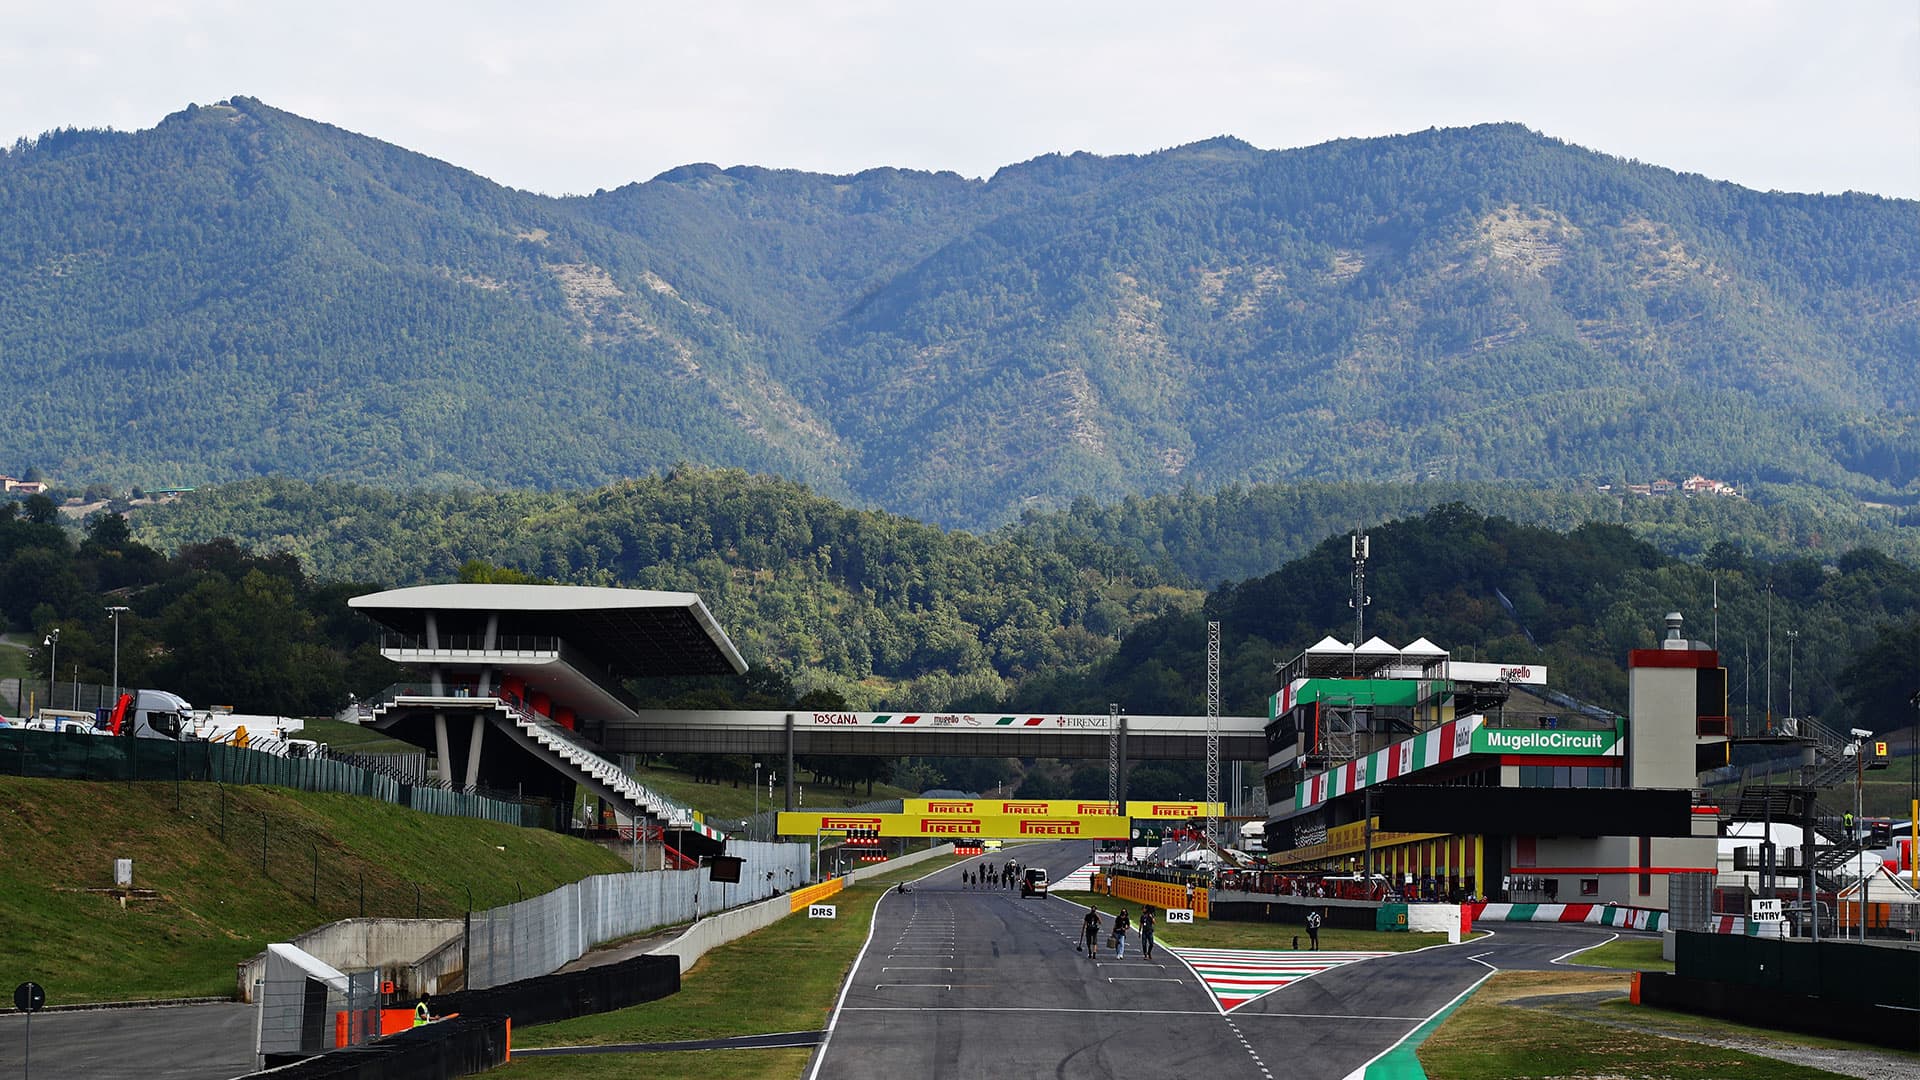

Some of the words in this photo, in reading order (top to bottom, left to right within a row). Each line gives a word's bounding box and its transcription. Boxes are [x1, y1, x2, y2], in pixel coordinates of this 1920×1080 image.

[1067, 716, 1108, 729] FIRENZE
[1487, 732, 1603, 750] MugelloCircuit
[1877, 744, 1885, 754] F
[928, 802, 974, 814] PIRELLI
[1003, 803, 1049, 815] PIRELLI
[1078, 804, 1120, 815] PIRELL
[1153, 805, 1199, 816] PIRELLI
[921, 819, 981, 834] PIRELLI
[1020, 820, 1081, 835] PIRELLI
[1759, 901, 1773, 910] PIT
[811, 908, 833, 917] DRS
[1169, 912, 1191, 921] DRS
[1753, 911, 1780, 921] ENTRY
[383, 982, 391, 992] F
